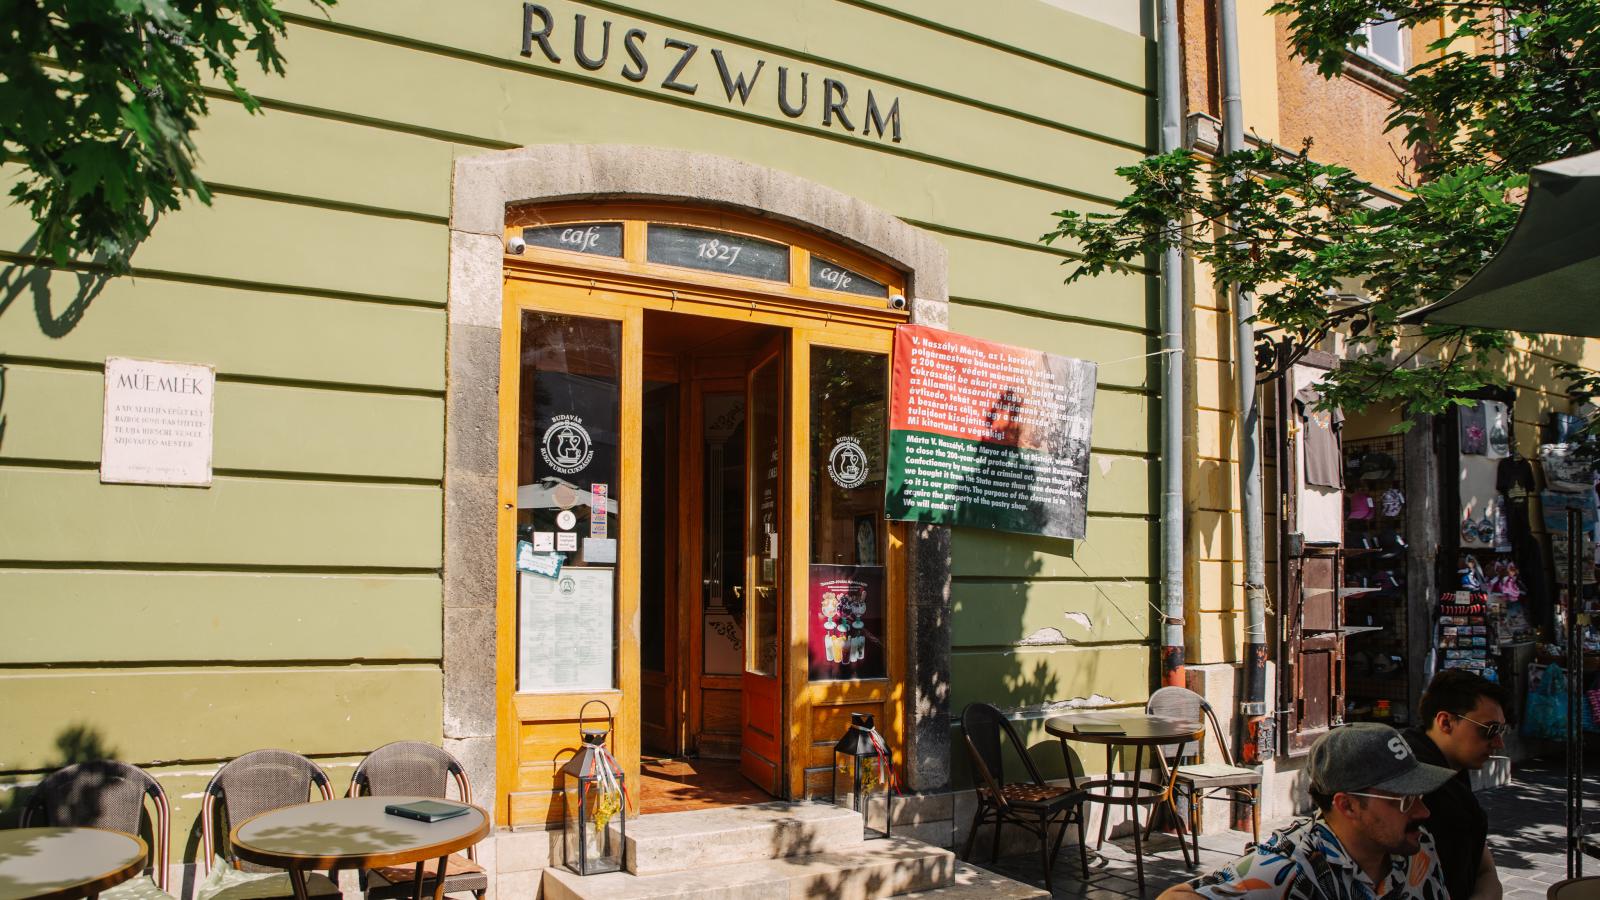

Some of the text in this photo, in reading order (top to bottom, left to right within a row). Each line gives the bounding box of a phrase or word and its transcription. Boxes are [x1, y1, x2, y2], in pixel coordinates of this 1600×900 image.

[519, 1, 902, 143] RUSZWURM
[698, 238, 742, 267] 1827
[820, 267, 852, 290] cafe
[912, 336, 920, 345] V.
[922, 338, 957, 353] Naszályi
[959, 345, 986, 359] Márta,
[919, 357, 934, 367] 200
[958, 374, 968, 384] be
[970, 376, 997, 390] akarja
[908, 396, 914, 404] A
[982, 408, 1001, 421] hogy
[979, 398, 989, 407] mi
[1003, 391, 1021, 402] több
[1023, 396, 1040, 406] mint
[907, 416, 918, 425] Mi
[921, 417, 957, 431] kitartunk
[908, 405, 946, 419] tulajdont
[906, 434, 928, 444] Márta
[966, 443, 977, 452] the
[978, 446, 999, 456] Mayor
[1008, 450, 1018, 458] the
[916, 445, 933, 455] close
[935, 448, 945, 457] the
[946, 450, 986, 464] 200-year-old
[987, 457, 1017, 468] protected
[1019, 462, 1050, 473] monument
[905, 455, 952, 469] Confectionery
[952, 462, 960, 471] by
[996, 469, 1022, 478] criminal
[1051, 476, 1072, 487] though
[917, 467, 942, 478] bought
[949, 472, 964, 480] from
[975, 476, 991, 484] State
[1011, 481, 1025, 489] than
[1027, 483, 1043, 492] three
[1044, 485, 1068, 495] decades
[1069, 490, 1082, 498] ago,
[903, 487, 930, 498] acquire
[932, 490, 943, 498] the
[944, 493, 972, 503] property
[980, 496, 990, 505] the
[990, 498, 1009, 509] pastry
[1011, 501, 1028, 511] shop.
[943, 482, 971, 493] property.
[972, 485, 982, 494] The
[983, 489, 1008, 498] purpose
[1018, 491, 1028, 500] the
[1030, 492, 1051, 503] closure
[916, 499, 929, 507] will
[930, 501, 956, 511] endure!
[1388, 734, 1412, 760] S
